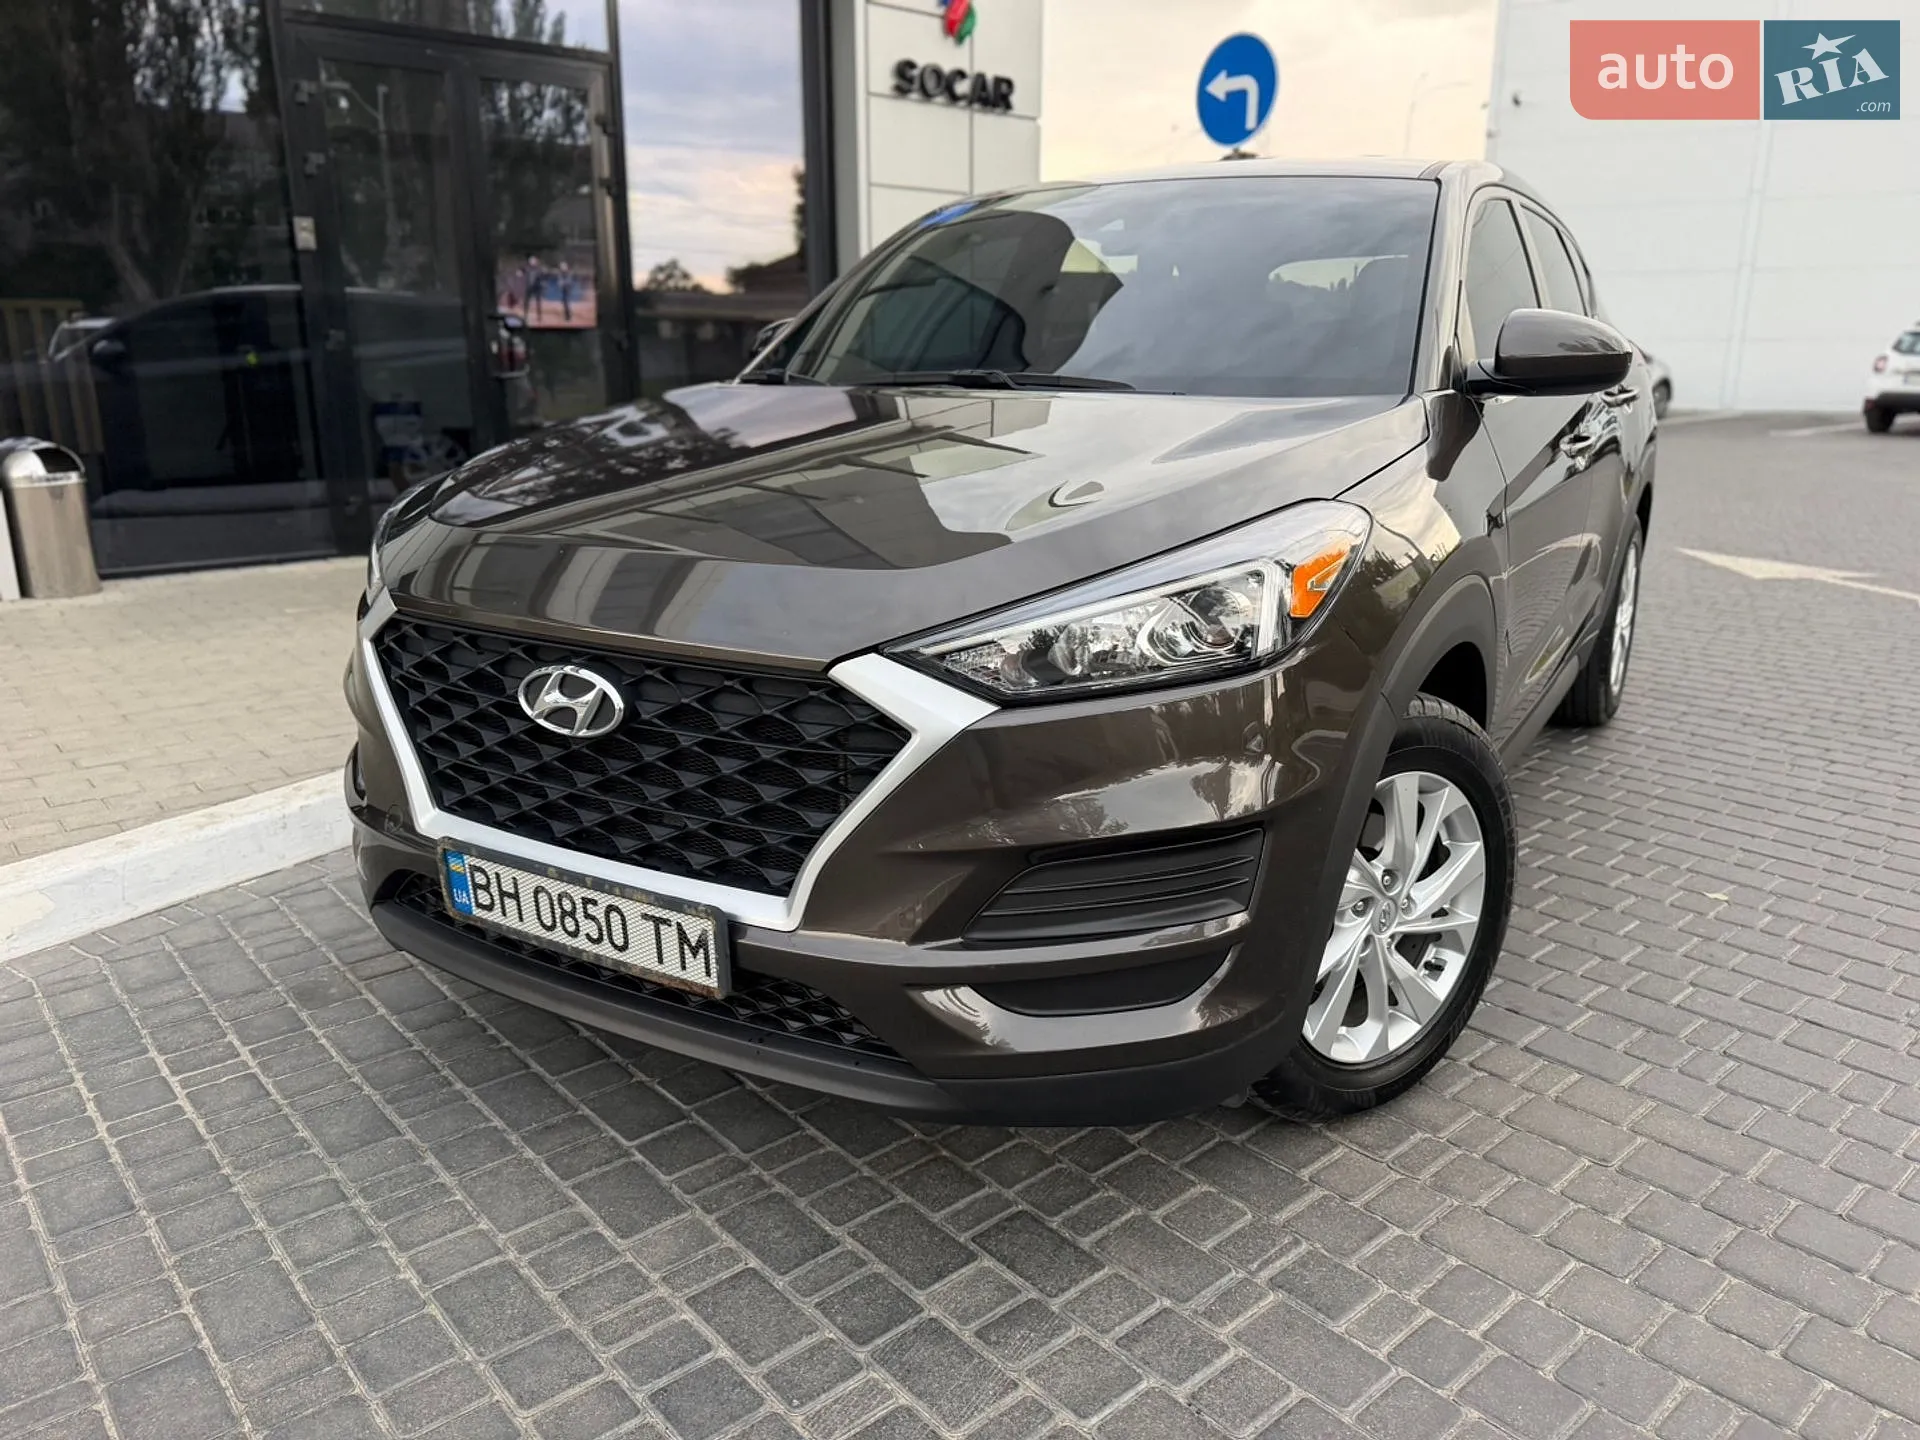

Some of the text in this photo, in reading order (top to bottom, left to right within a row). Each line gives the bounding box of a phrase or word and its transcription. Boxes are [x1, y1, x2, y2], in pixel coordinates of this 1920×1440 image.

[893, 58, 1014, 111] SOCAR
[454, 888, 469, 905] UA
[469, 864, 712, 978] BH 0850 TM
